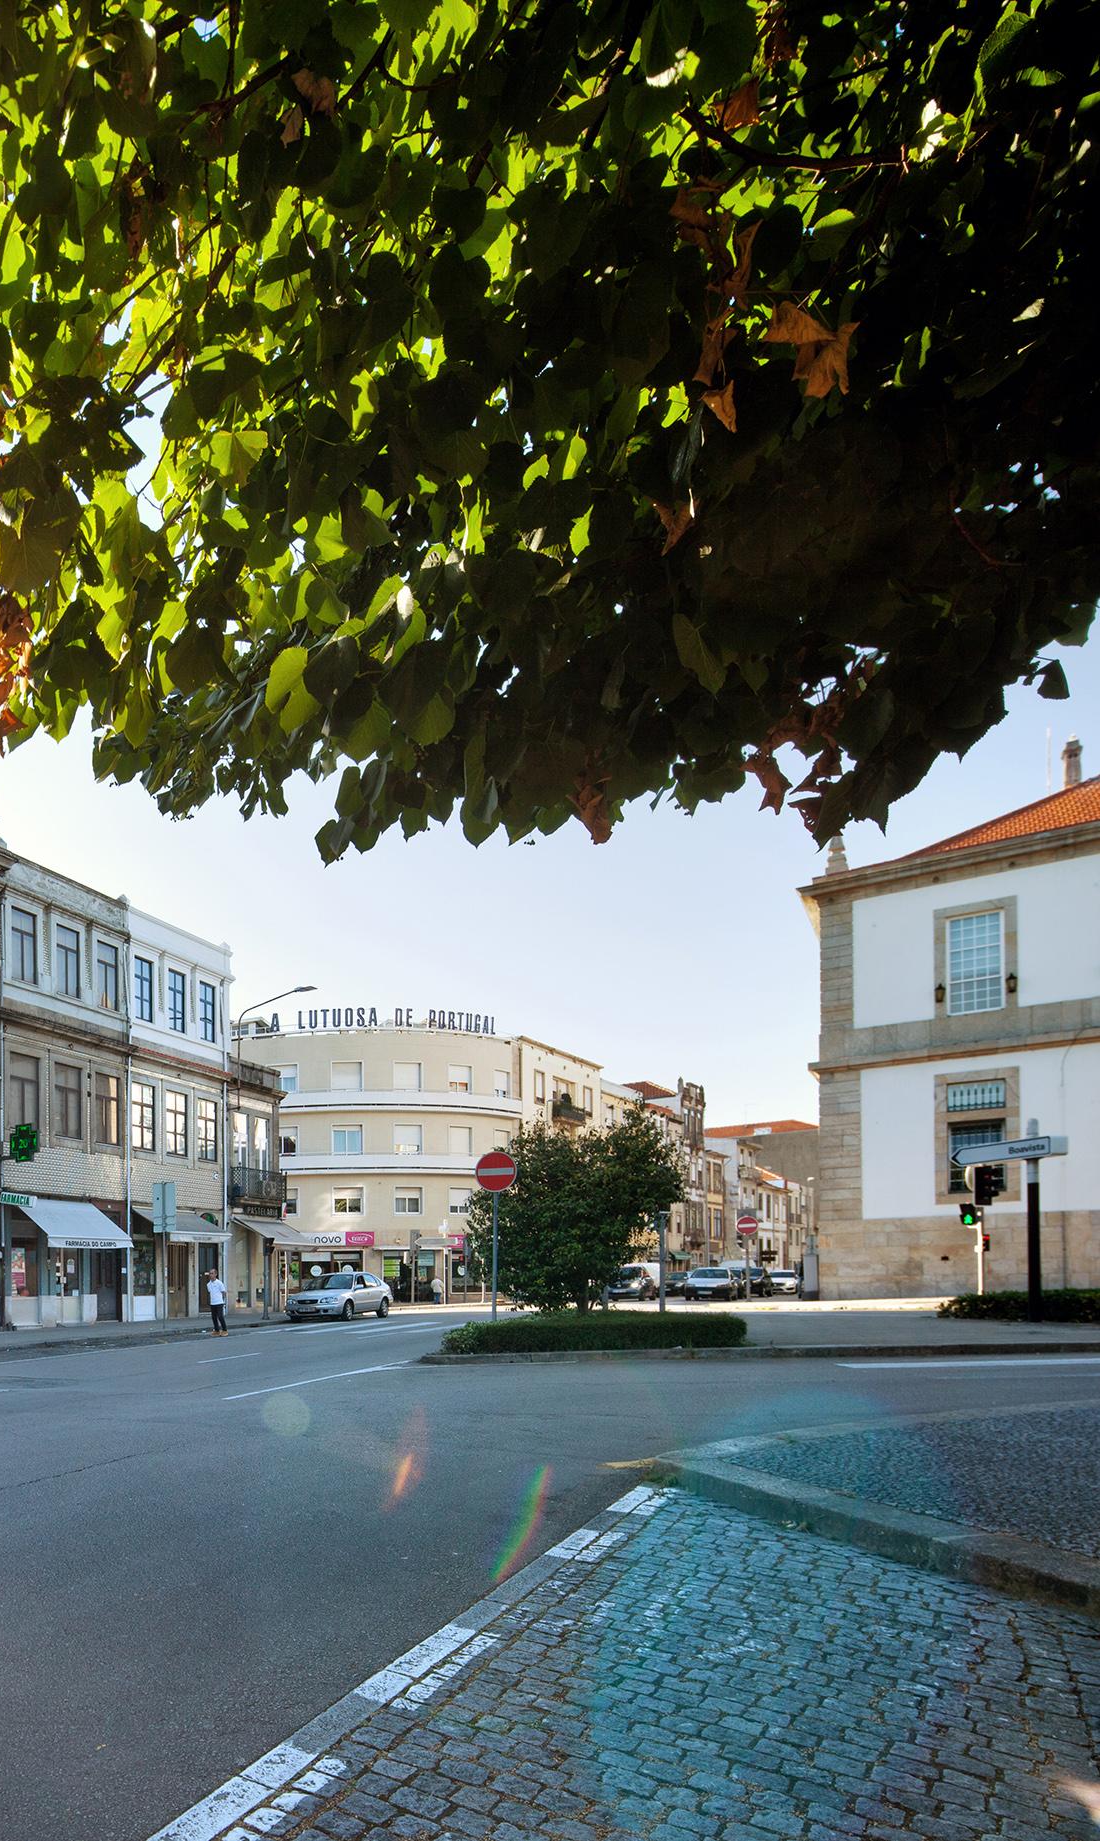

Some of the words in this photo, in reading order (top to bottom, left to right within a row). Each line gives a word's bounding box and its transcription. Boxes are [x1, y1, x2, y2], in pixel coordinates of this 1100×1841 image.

[271, 1013, 281, 1032] A
[298, 1007, 378, 1029] LUTUOSA
[395, 1008, 413, 1027] DE
[429, 1009, 496, 1035] PORTUGAL
[1008, 1144, 1045, 1154] Boavista
[1, 1193, 30, 1206] FARMACIA
[247, 1206, 278, 1216] PASTELARIA
[314, 1236, 342, 1244] novo
